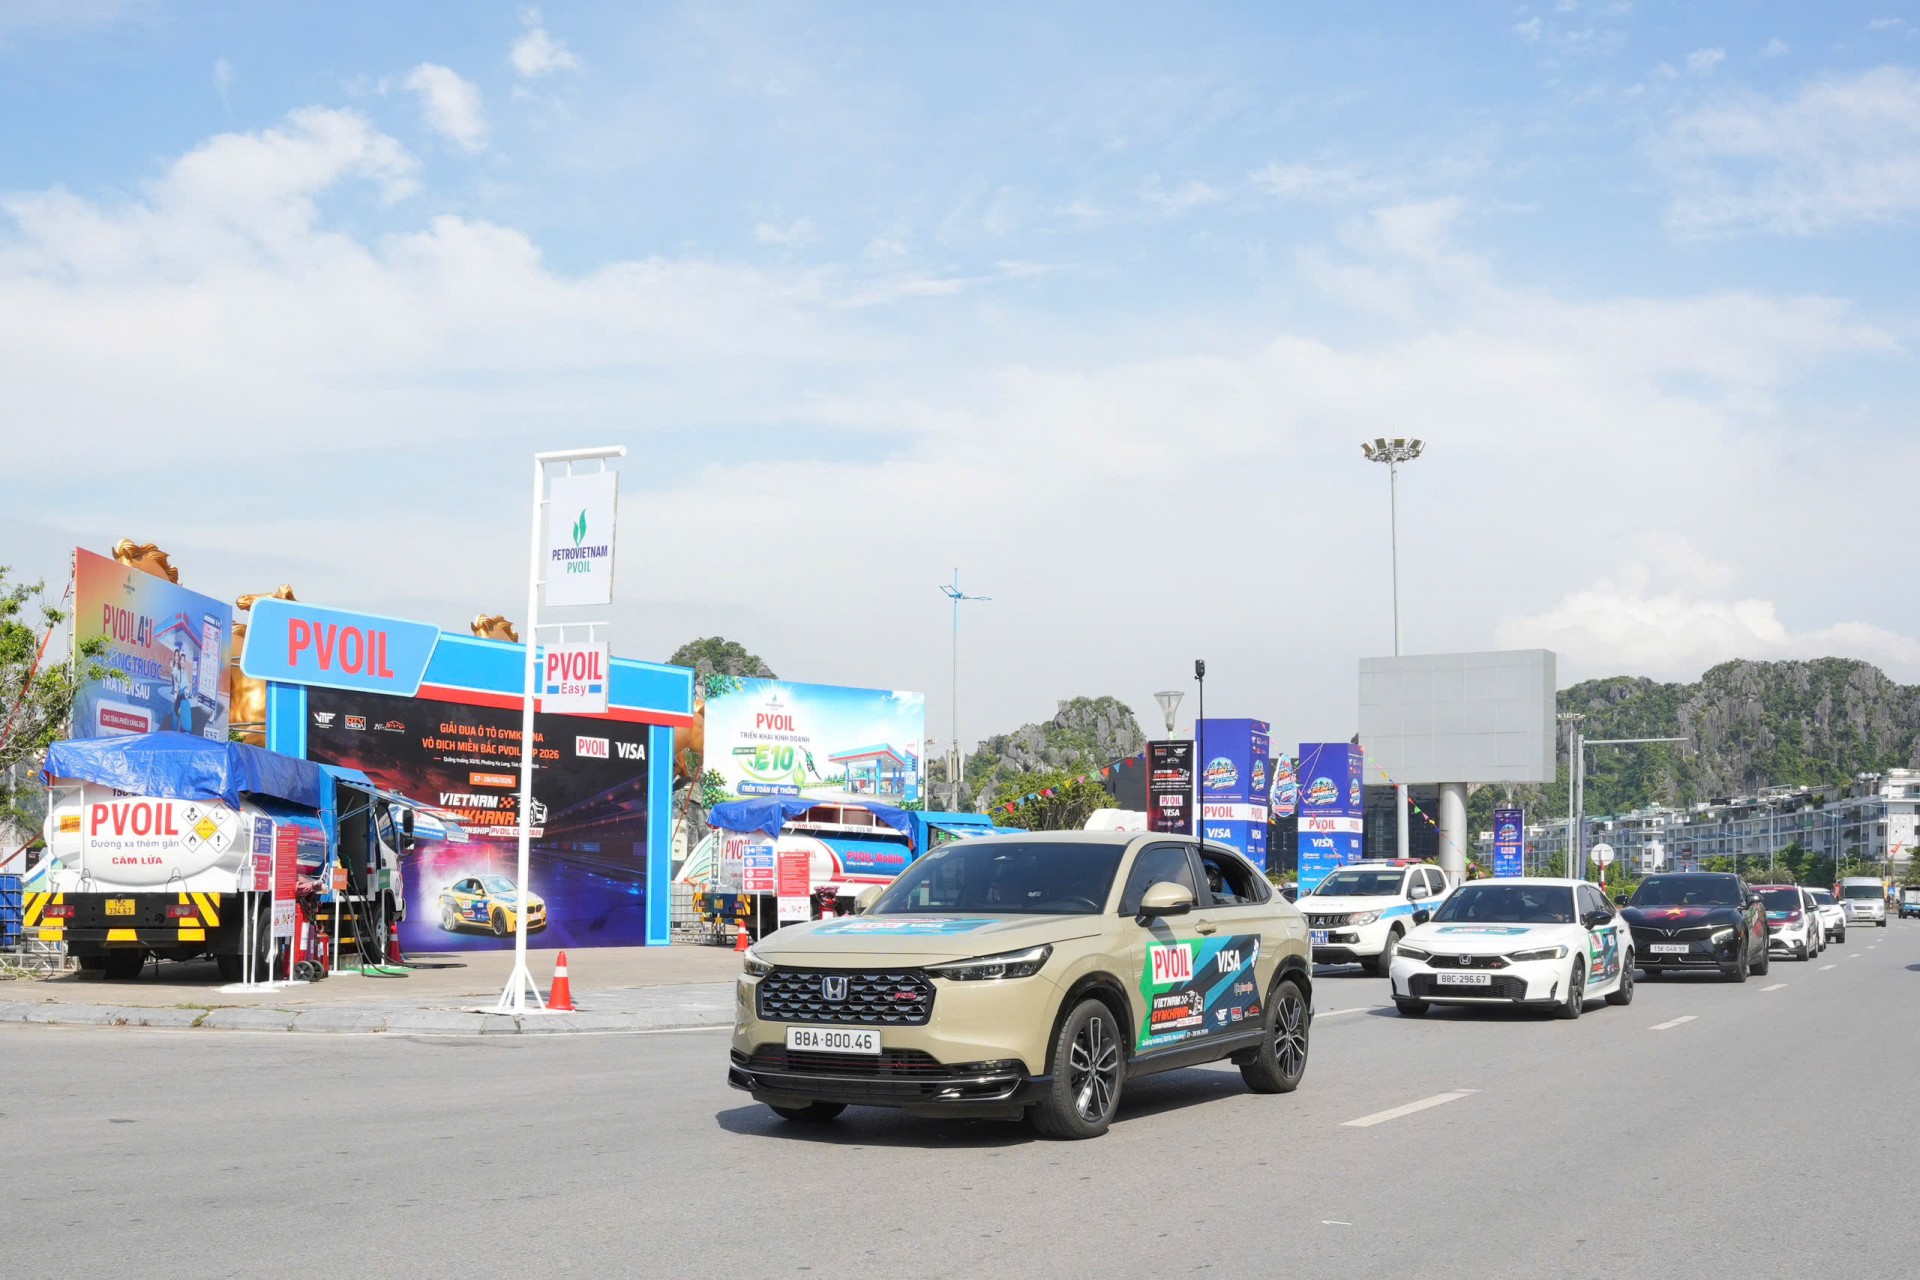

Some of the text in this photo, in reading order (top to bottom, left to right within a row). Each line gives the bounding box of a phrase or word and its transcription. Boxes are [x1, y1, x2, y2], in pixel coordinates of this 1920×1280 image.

[552, 545, 608, 561] PETROVIETNAM
[566, 560, 591, 574] PVOIL
[288, 617, 394, 679] PVOIL
[547, 651, 602, 681] PVOIL
[561, 682, 586, 696] Easy
[756, 712, 795, 732] PVOIL
[440, 720, 544, 742] GIẢI ĐUA Ô TÔ GYMKNA
[422, 736, 434, 749] VÔ
[436, 740, 455, 752] ĐỊCH
[457, 737, 479, 753] MIỀN
[480, 739, 497, 754] BẮC
[498, 745, 522, 756] PVOIL
[790, 735, 810, 743] DOANH
[539, 748, 560, 759] 2026
[578, 738, 646, 760] PVOIL VISA
[754, 744, 794, 771] E10
[440, 792, 499, 808] VIETNAM
[1161, 796, 1181, 805] PVOIL
[91, 802, 179, 836] PVOIL
[1162, 808, 1180, 817] VISA
[1204, 806, 1234, 818] PVOIL
[1206, 828, 1232, 839] VISA
[91, 839, 122, 849] Đường
[136, 839, 160, 848] thêm
[162, 840, 179, 850] gần
[1310, 838, 1334, 848] VISA
[846, 851, 874, 863] PVOIL
[876, 853, 905, 865] Mobile
[1154, 948, 1190, 980] PVOIL
[1215, 949, 1241, 973] VISA
[893, 991, 917, 1000] RS
[1154, 995, 1181, 1009] VIETNAM
[794, 1031, 872, 1050] 88A-800.46
